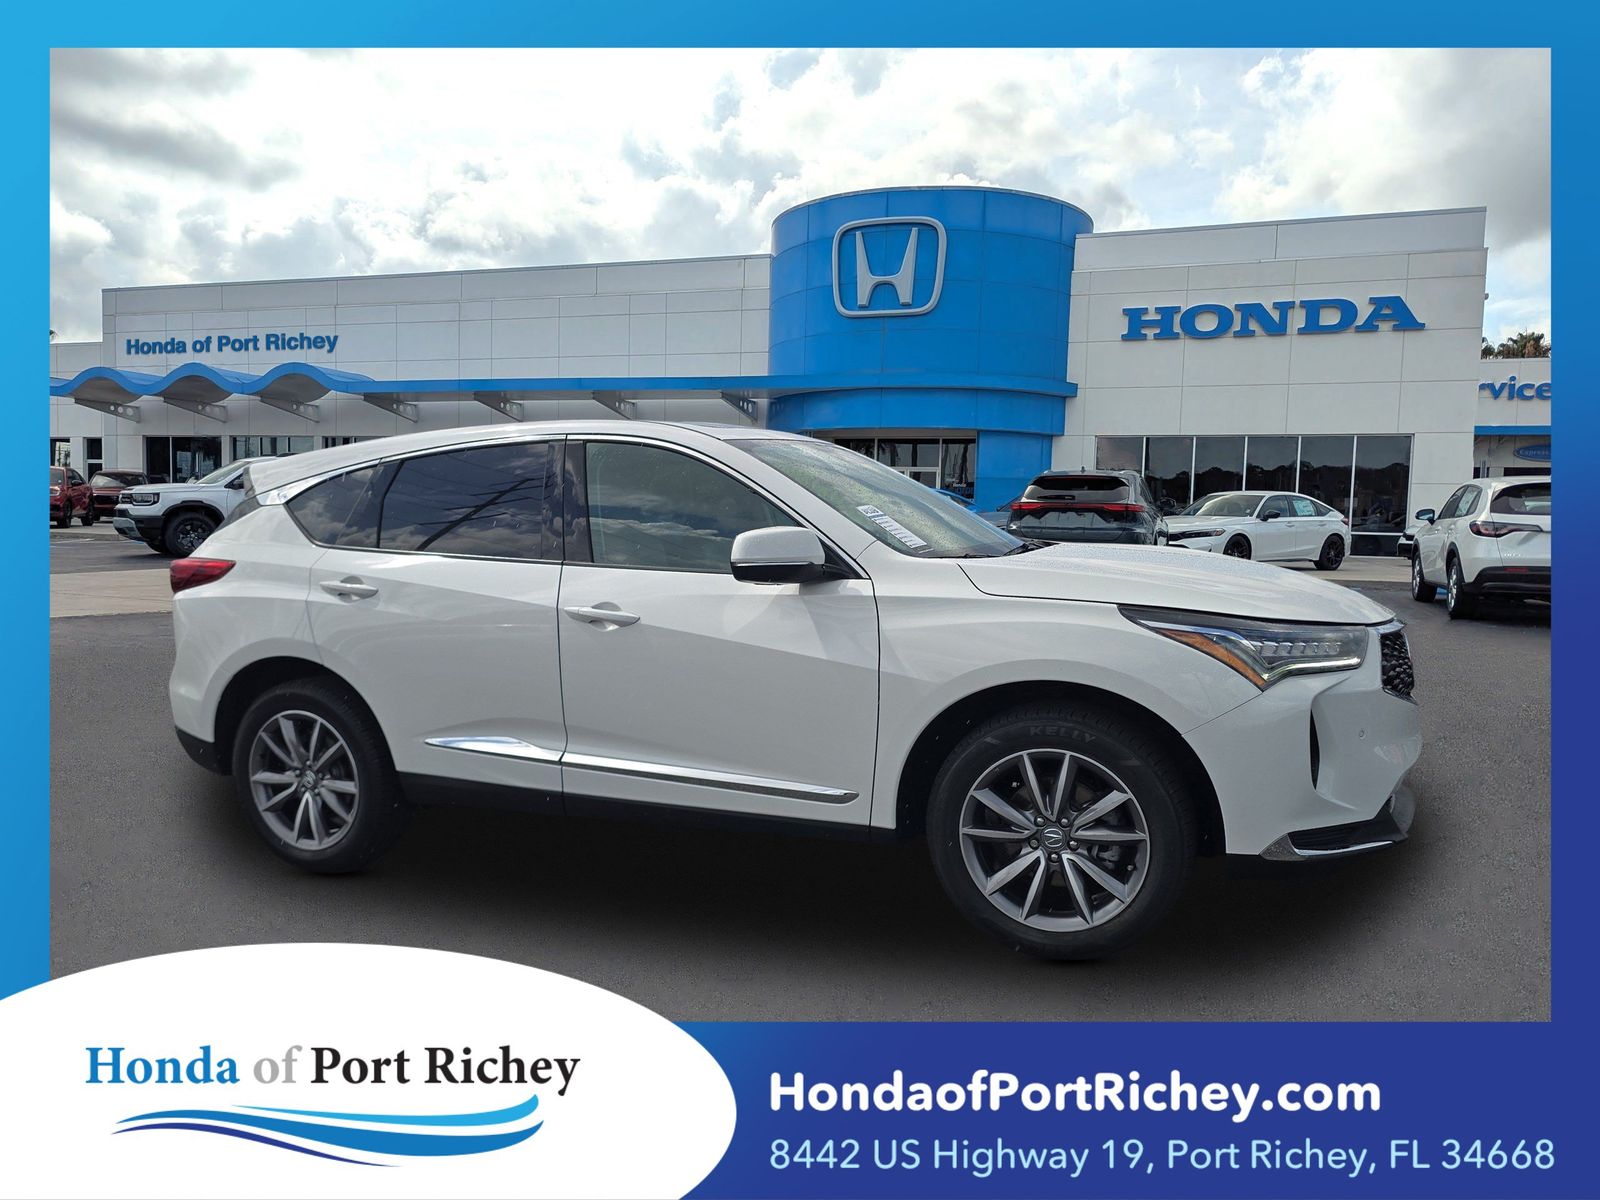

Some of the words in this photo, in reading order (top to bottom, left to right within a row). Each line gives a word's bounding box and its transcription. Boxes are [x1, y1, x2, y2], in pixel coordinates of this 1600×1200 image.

[1121, 295, 1426, 341] HONDA
[126, 337, 187, 355] Honda
[191, 336, 213, 353] of
[217, 334, 260, 352] Port
[265, 332, 339, 353] Richey
[1029, 726, 1096, 743] KELLY
